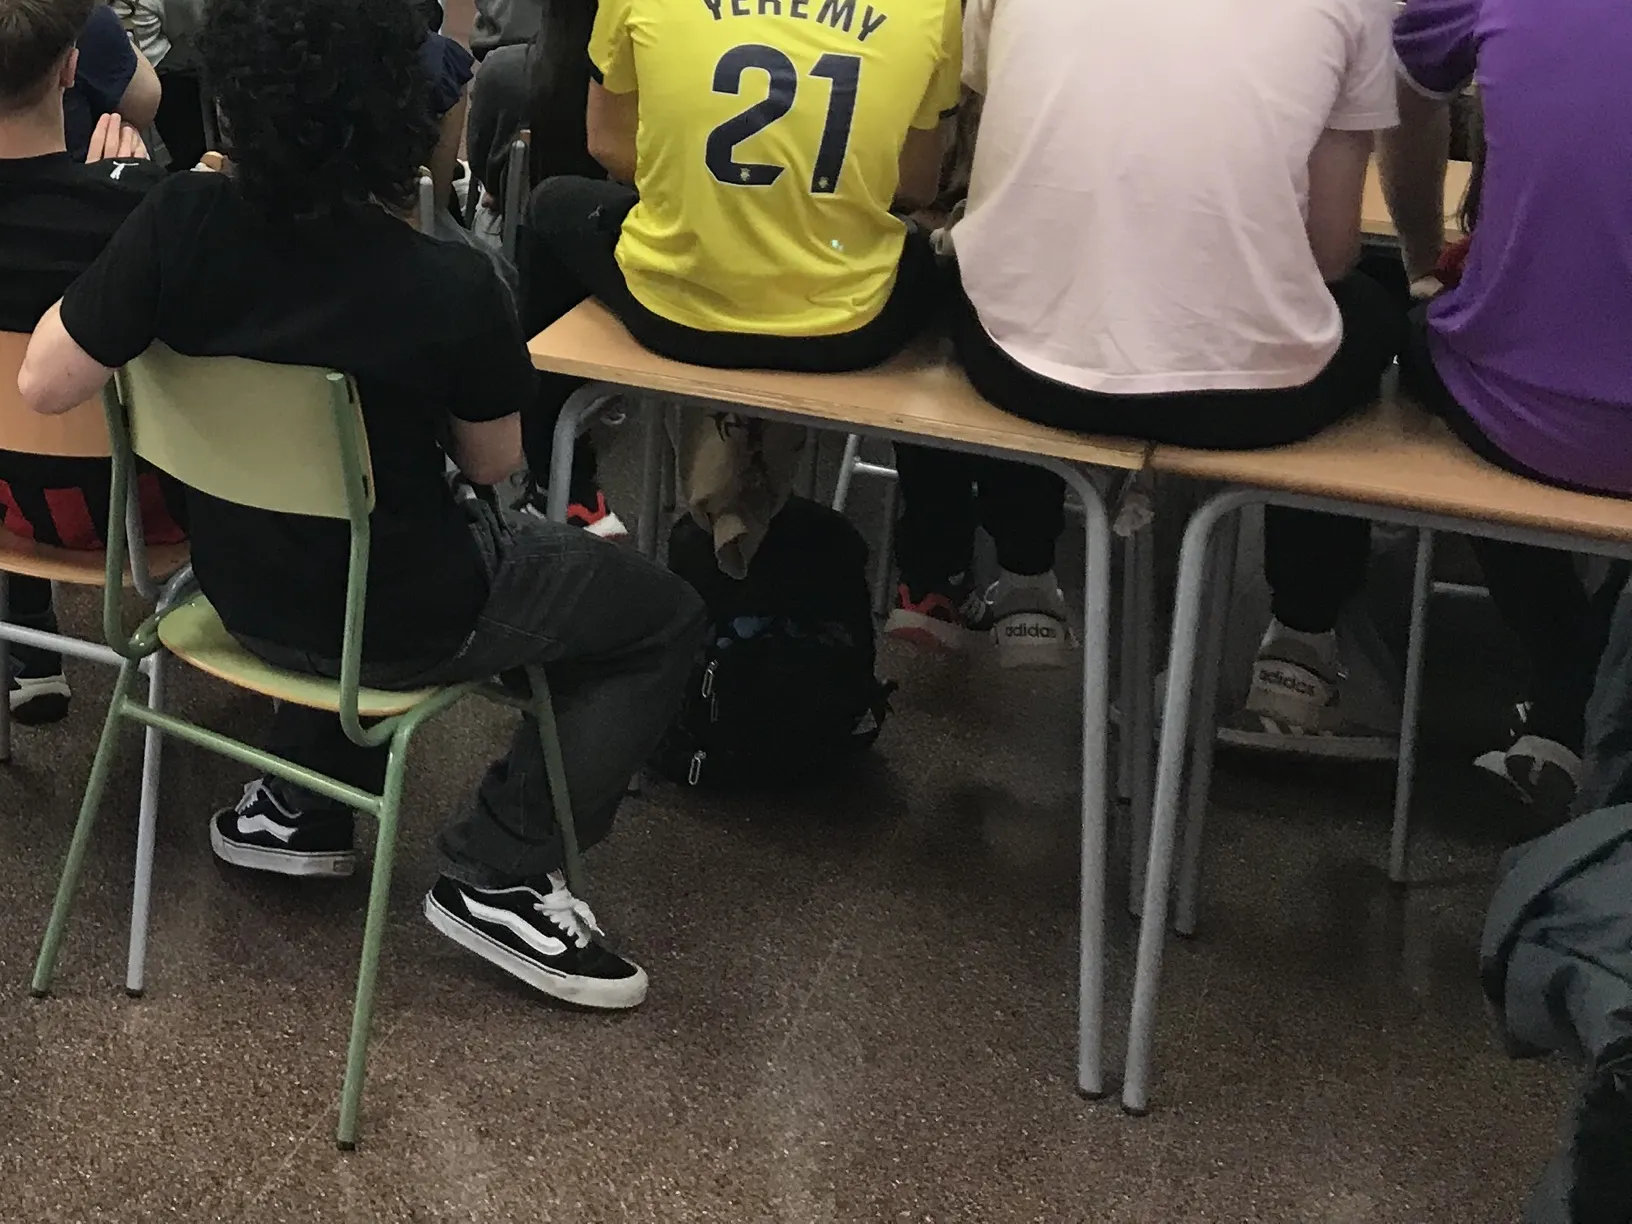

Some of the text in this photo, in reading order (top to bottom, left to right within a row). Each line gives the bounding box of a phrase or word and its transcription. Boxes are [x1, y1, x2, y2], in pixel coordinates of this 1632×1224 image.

[704, 43, 863, 195] 21
[1005, 623, 1056, 638] adidas
[1260, 668, 1316, 697] adidas
